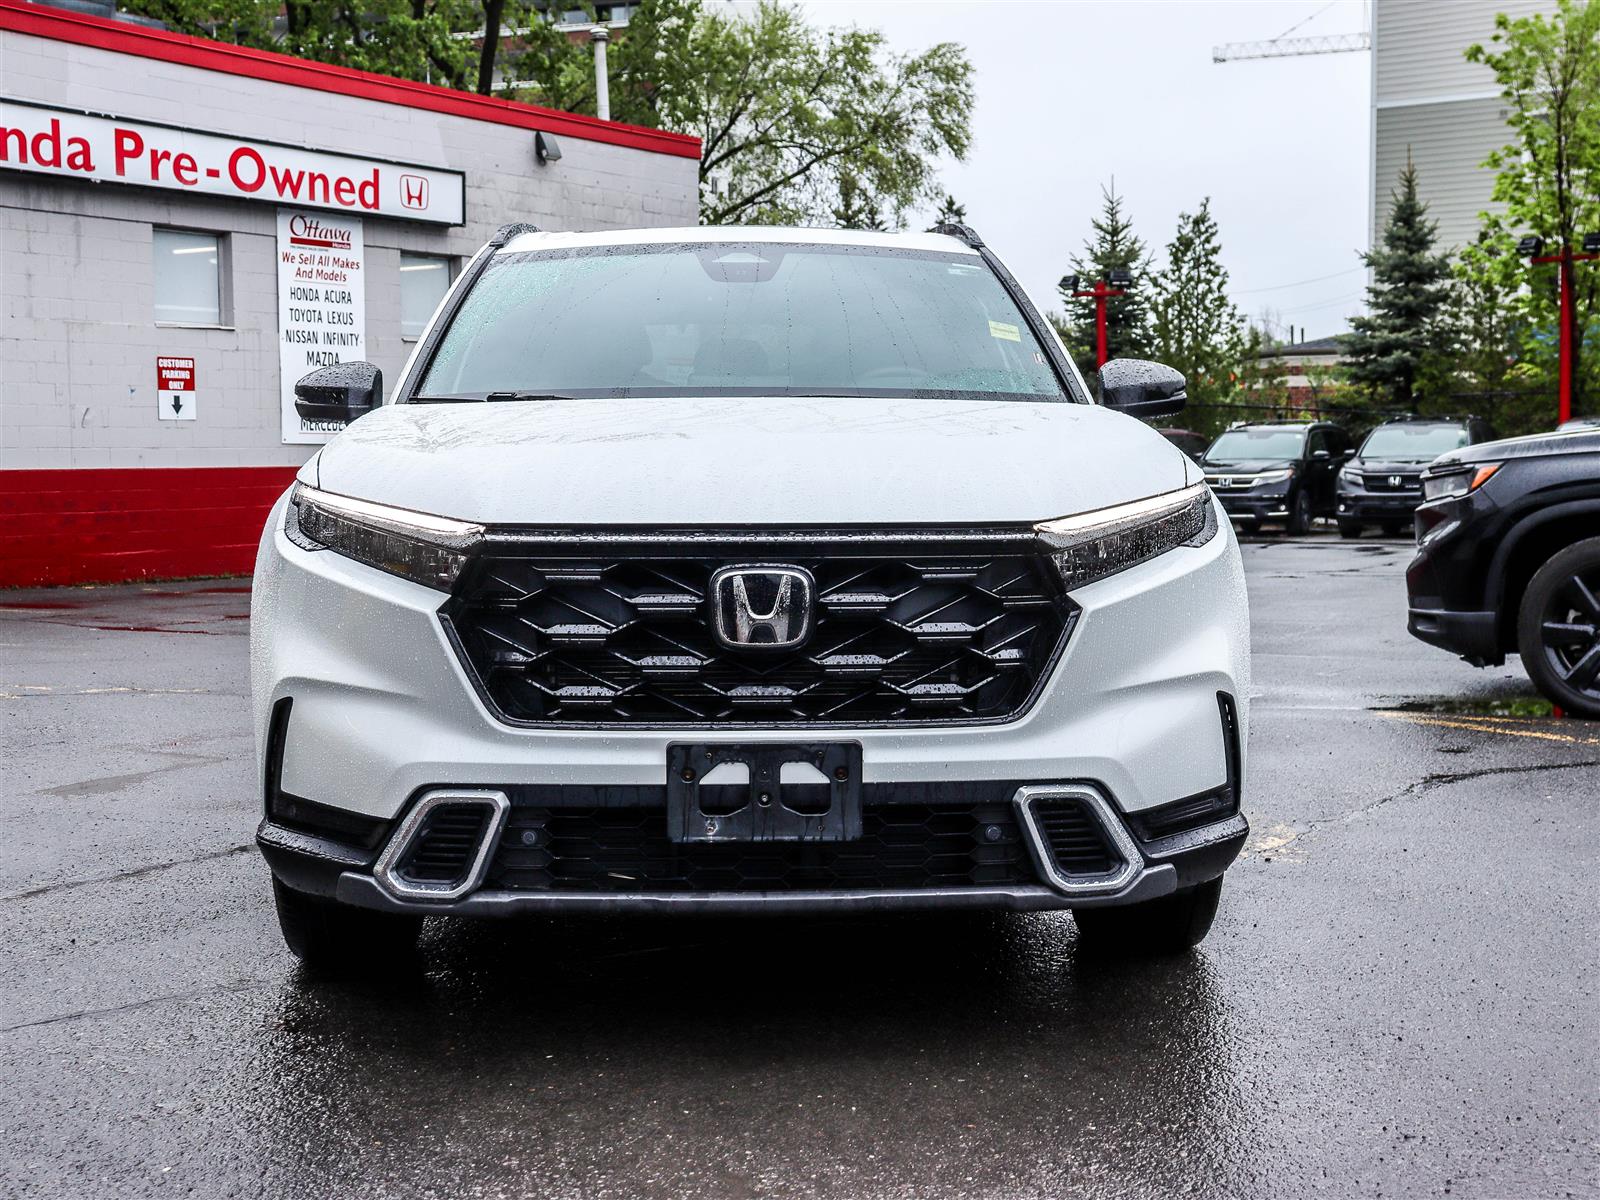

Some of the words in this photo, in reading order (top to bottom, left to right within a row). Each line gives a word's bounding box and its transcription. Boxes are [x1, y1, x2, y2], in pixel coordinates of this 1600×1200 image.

[0, 118, 96, 172] nda
[114, 128, 381, 211] Pre-Owned
[289, 214, 351, 242] Ottawa
[282, 251, 296, 264] We
[298, 253, 316, 266] Sell
[317, 255, 330, 267] All
[332, 257, 360, 270] Makes
[295, 267, 314, 279] And
[315, 269, 347, 282] Models
[290, 286, 320, 302] HONDA
[324, 289, 353, 304] ACURA
[289, 307, 323, 324] TOYOTA
[326, 311, 354, 326] LEXUS
[285, 329, 319, 344] NISSAN
[323, 332, 360, 347] INFINITY
[159, 359, 193, 368] CUSTOMER
[306, 350, 340, 367] MAZDA
[162, 370, 190, 379] PARKING
[169, 381, 184, 389] ONLY
